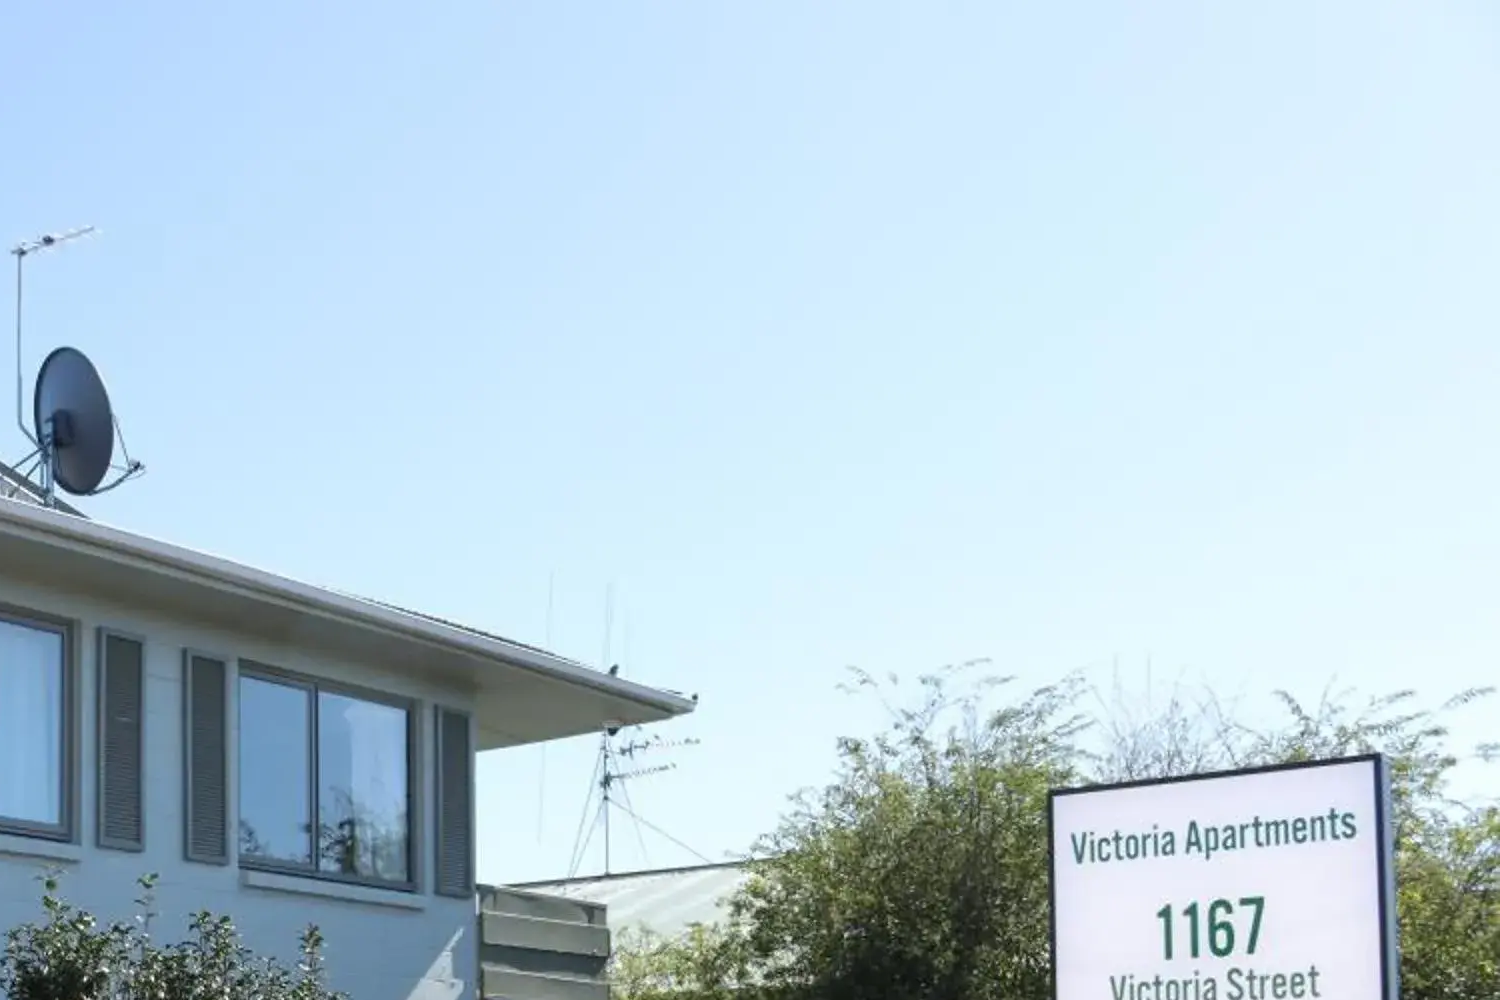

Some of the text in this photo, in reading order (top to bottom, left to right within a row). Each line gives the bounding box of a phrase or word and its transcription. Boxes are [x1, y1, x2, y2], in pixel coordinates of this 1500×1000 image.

[1071, 808, 1356, 864] Victoria Apartments
[1157, 896, 1264, 960] 1167
